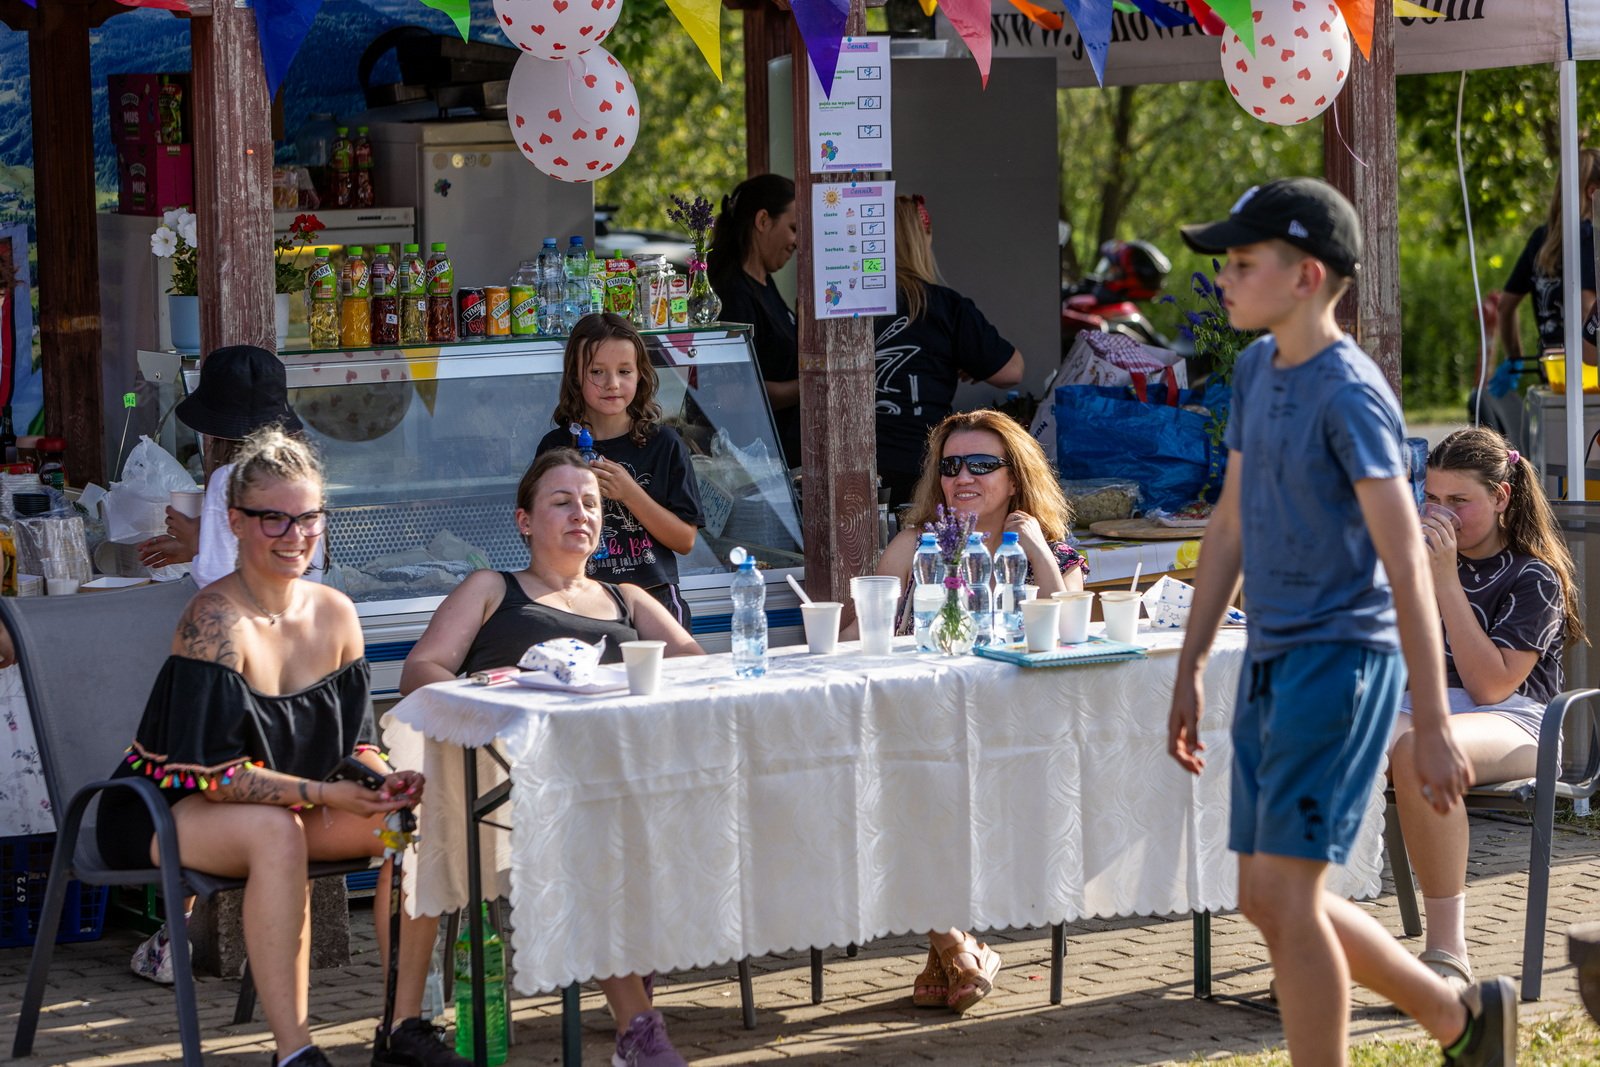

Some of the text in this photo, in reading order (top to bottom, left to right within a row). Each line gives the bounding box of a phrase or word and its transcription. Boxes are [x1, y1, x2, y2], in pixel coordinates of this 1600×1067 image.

[846, 42, 870, 50] Cennik
[123, 111, 139, 124] MUS
[132, 181, 146, 194] MUS
[850, 187, 874, 195] Cennik
[16, 876, 27, 903] 672
